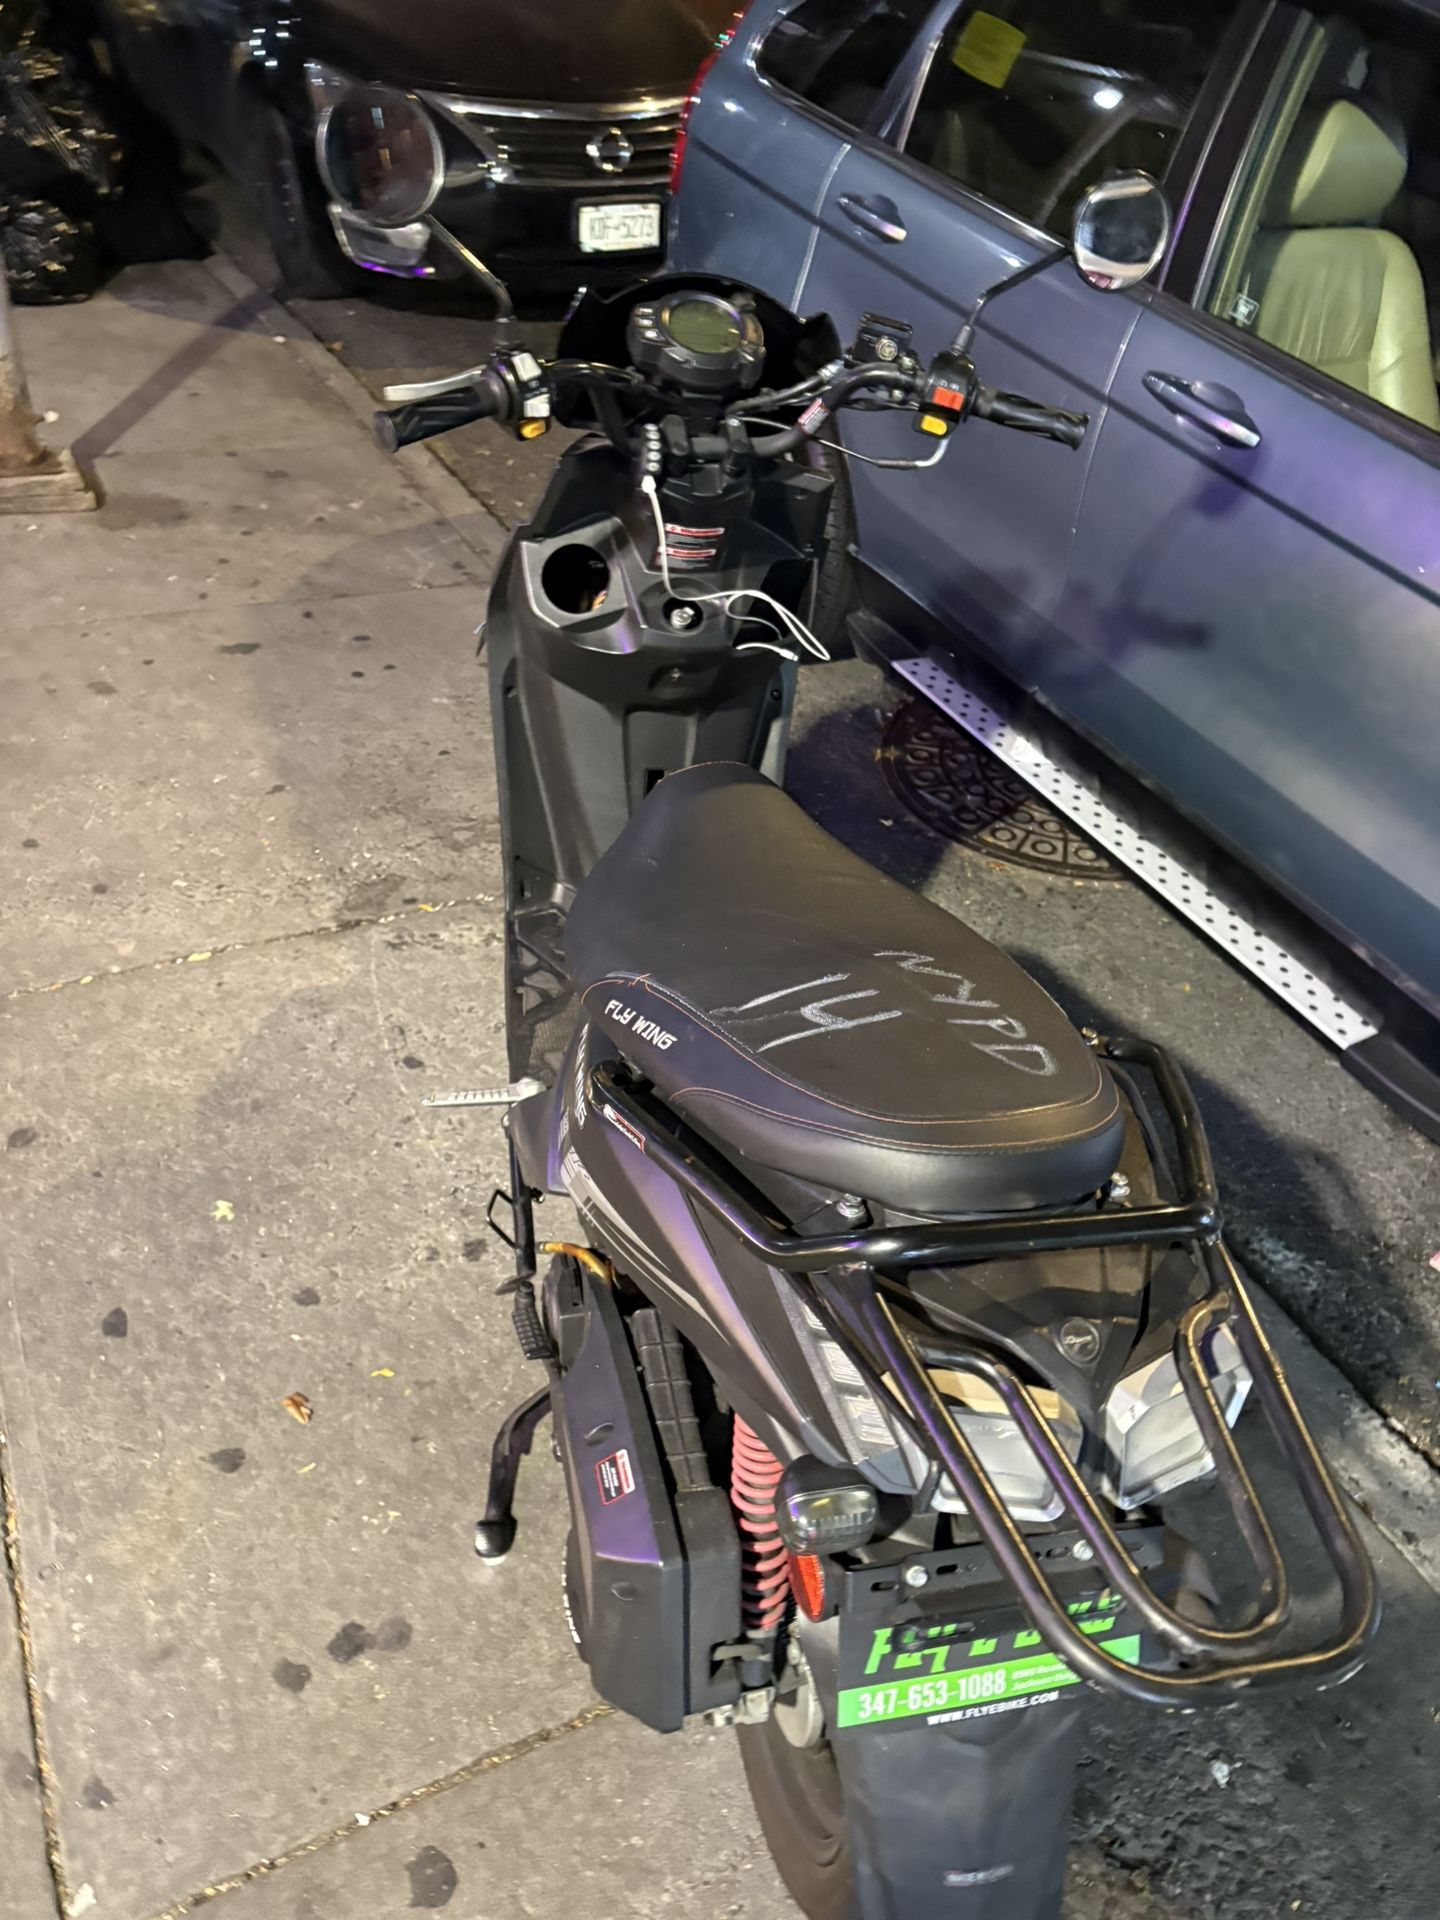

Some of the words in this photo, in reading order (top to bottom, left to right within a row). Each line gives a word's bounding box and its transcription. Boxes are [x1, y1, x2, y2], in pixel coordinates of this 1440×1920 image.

[604, 999, 637, 1025] FLY
[631, 1015, 678, 1050] WING
[857, 1668, 1006, 1719] 347-653-1088
[926, 1690, 1060, 1726] WWW.FLYEBIKE.COM
